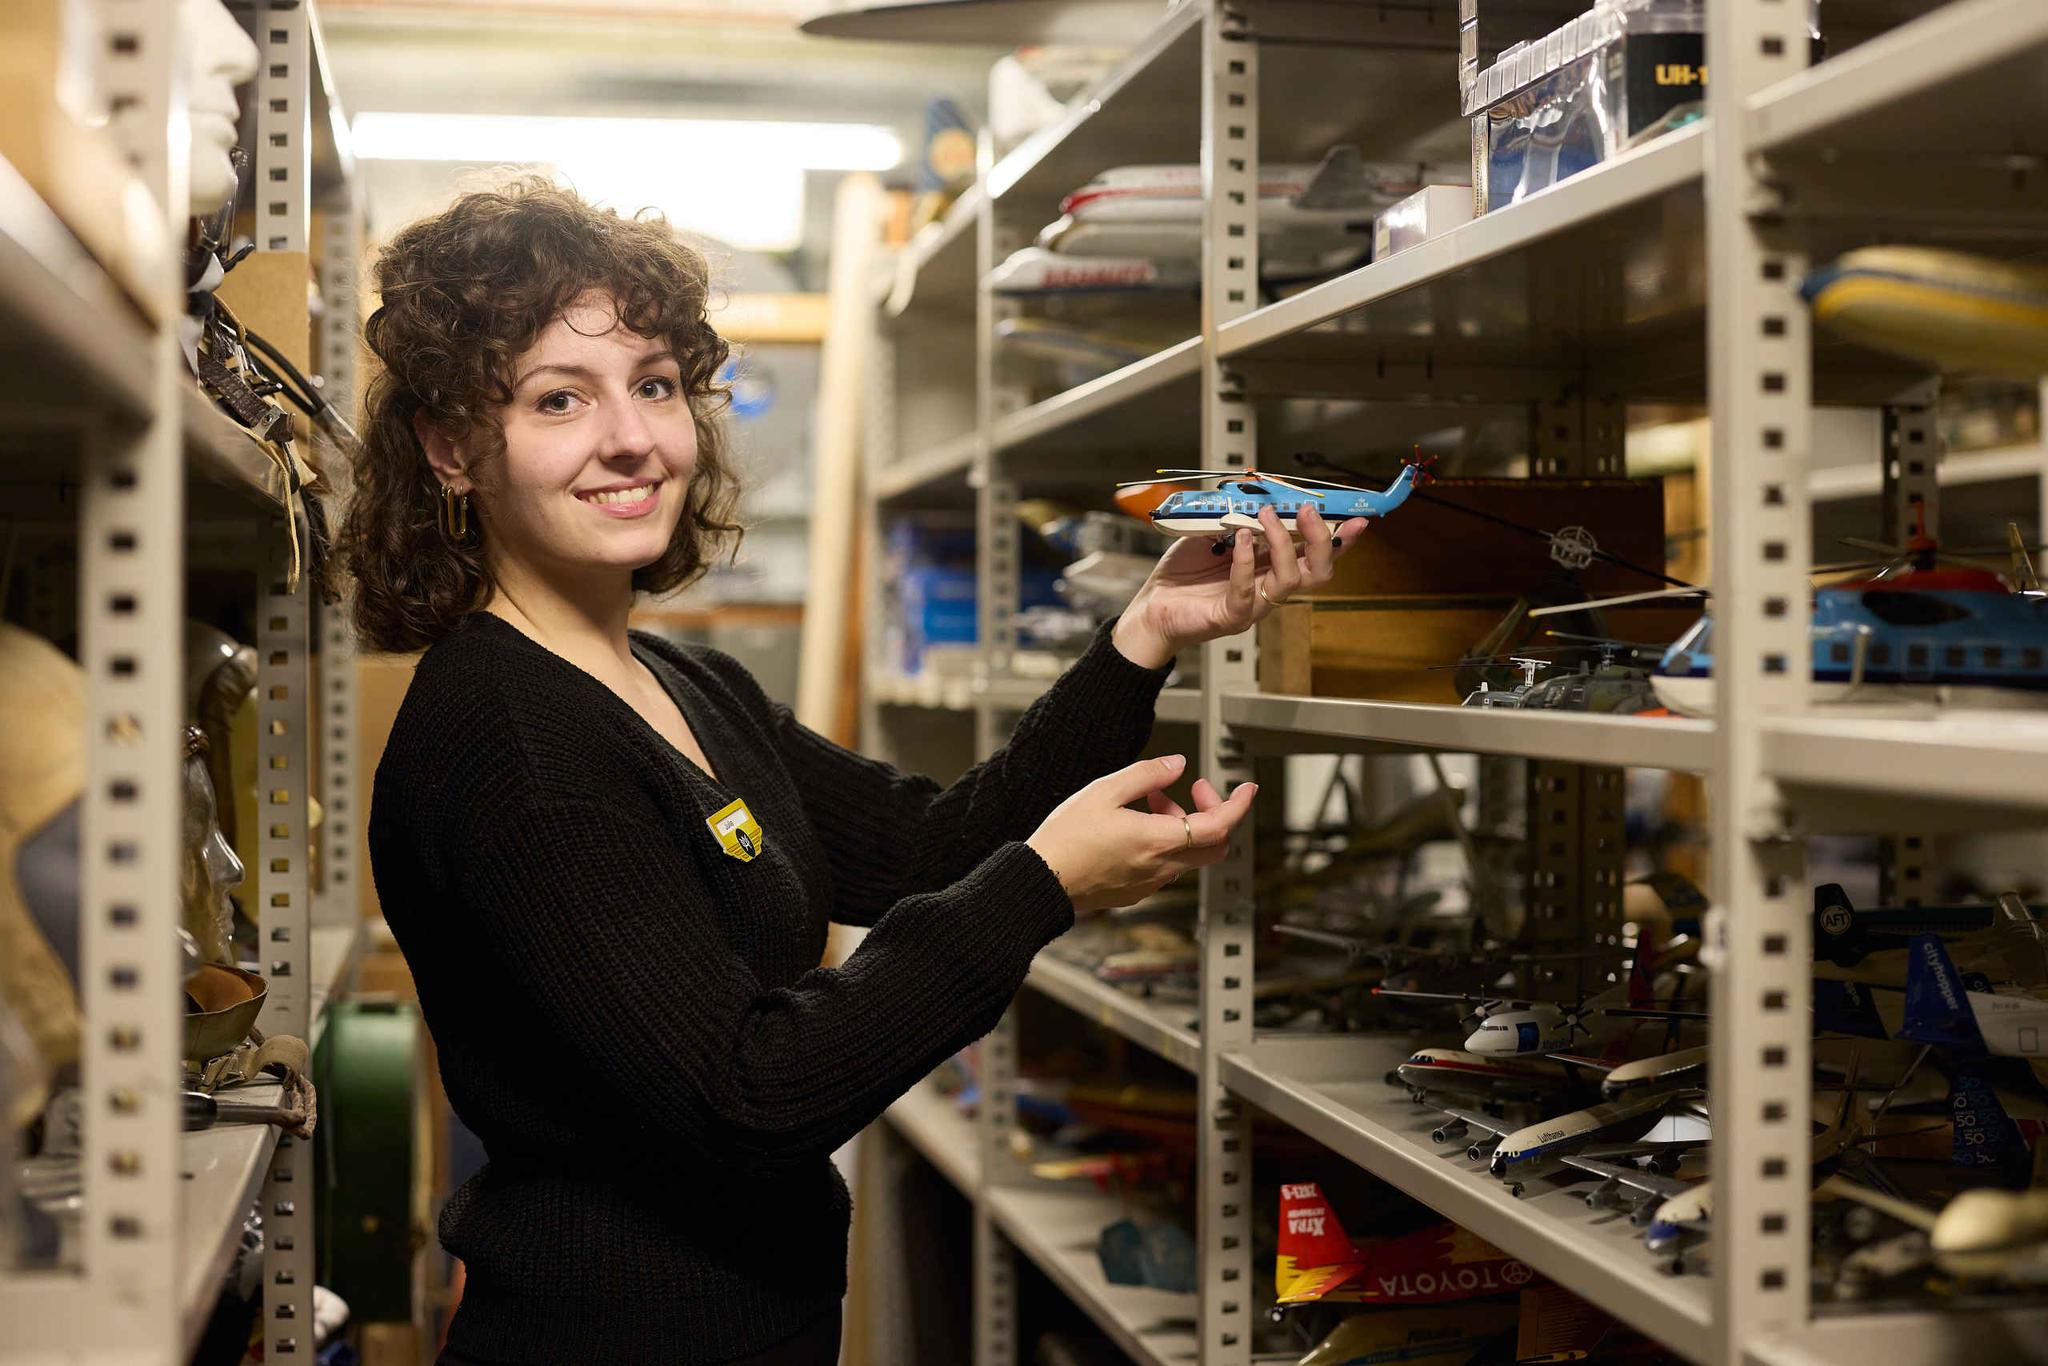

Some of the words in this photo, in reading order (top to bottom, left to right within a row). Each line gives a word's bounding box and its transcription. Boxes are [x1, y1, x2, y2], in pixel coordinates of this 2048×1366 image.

[1825, 912, 1846, 928] AFT
[1923, 942, 1959, 1011] cityhopper
[1956, 1115, 1976, 1128] 50
[1536, 1129, 1567, 1144] Lufthansa
[1965, 1133, 1985, 1146] 50
[1288, 1217, 1326, 1237] XTRA
[1379, 1269, 1499, 1297] TOYOTA
